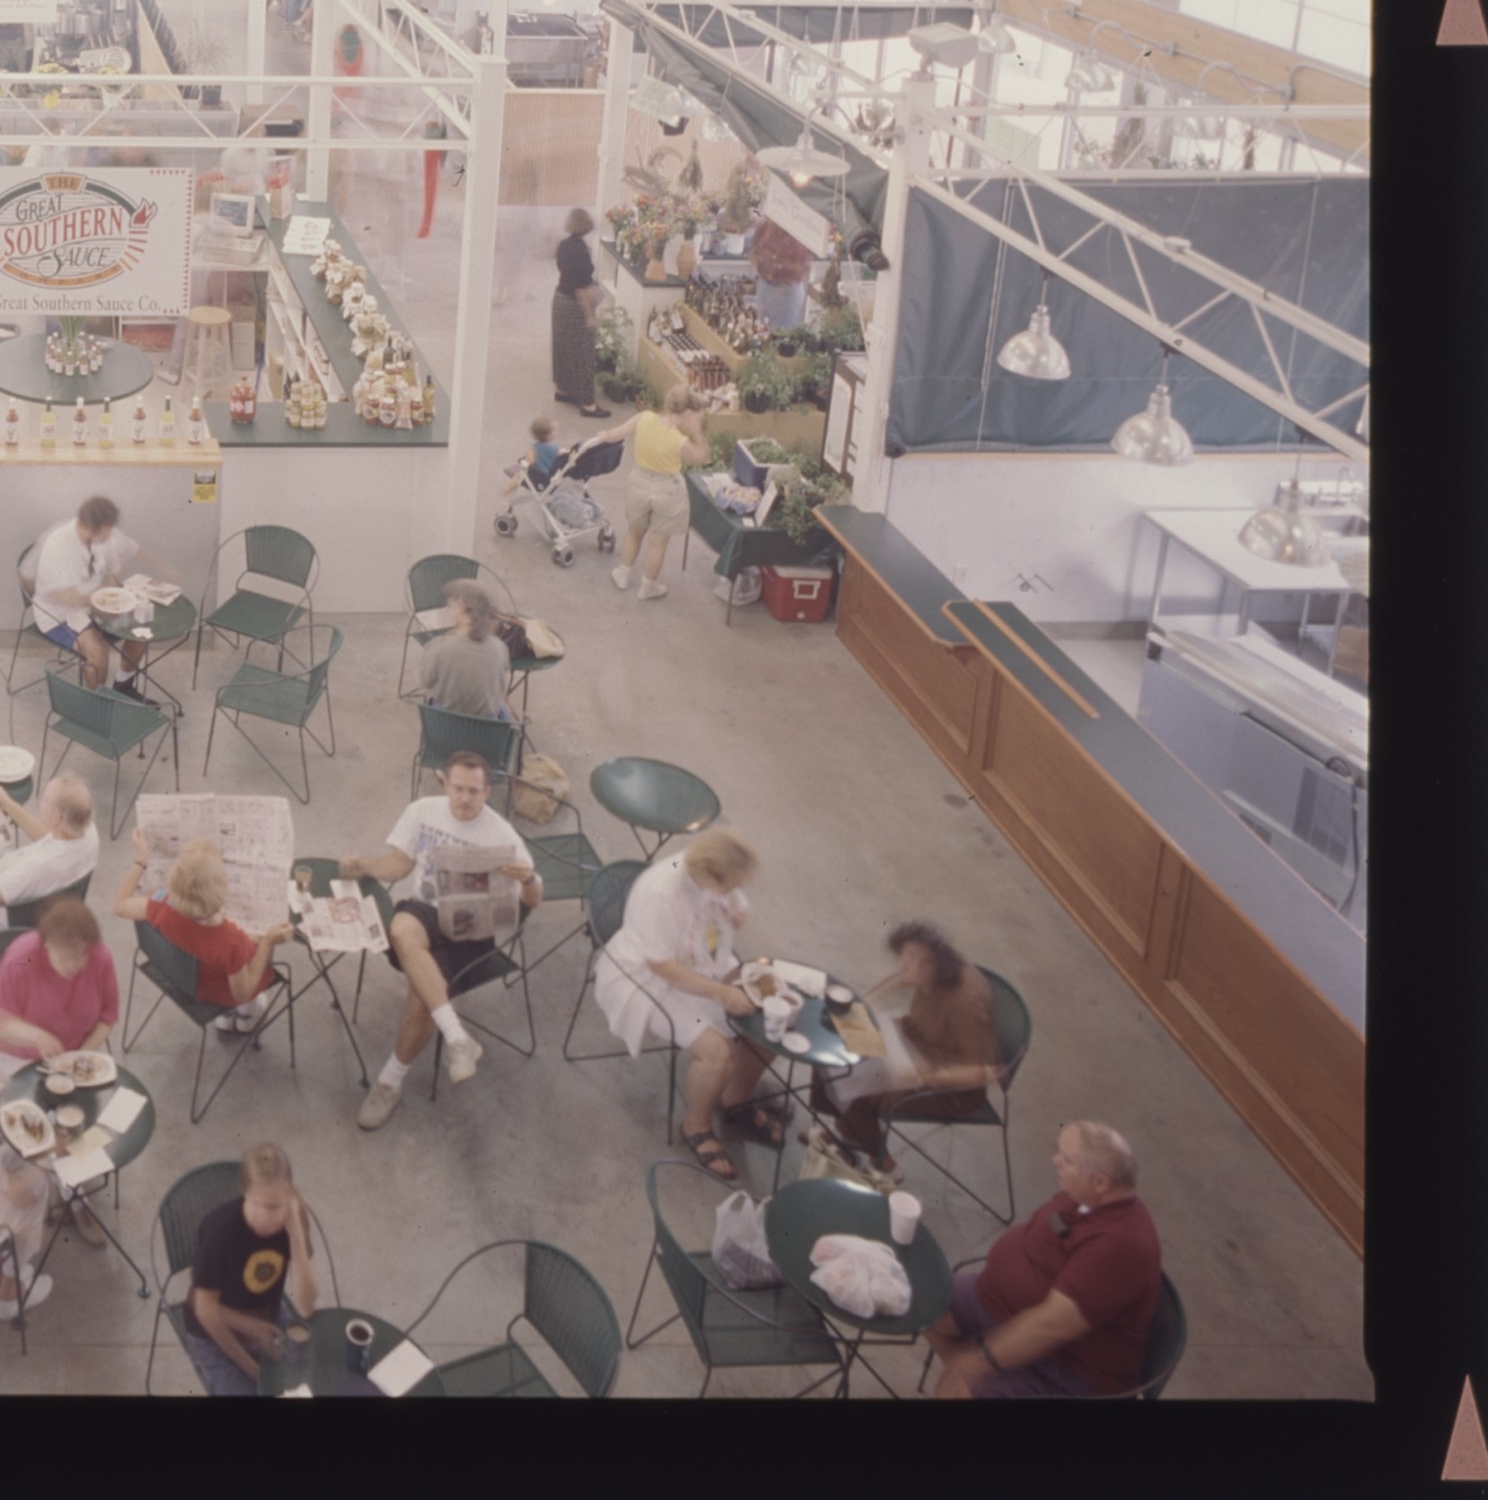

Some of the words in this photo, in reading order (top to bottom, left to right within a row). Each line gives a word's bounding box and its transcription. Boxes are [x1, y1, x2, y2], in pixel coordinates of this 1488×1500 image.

[47, 177, 78, 190] THE
[15, 194, 65, 222] GREAT
[3, 206, 125, 257] SOUTHERN
[36, 246, 111, 278] SAUCE
[32, 292, 93, 311] Southern
[96, 295, 133, 311] Sauce
[137, 295, 162, 312] Co.
